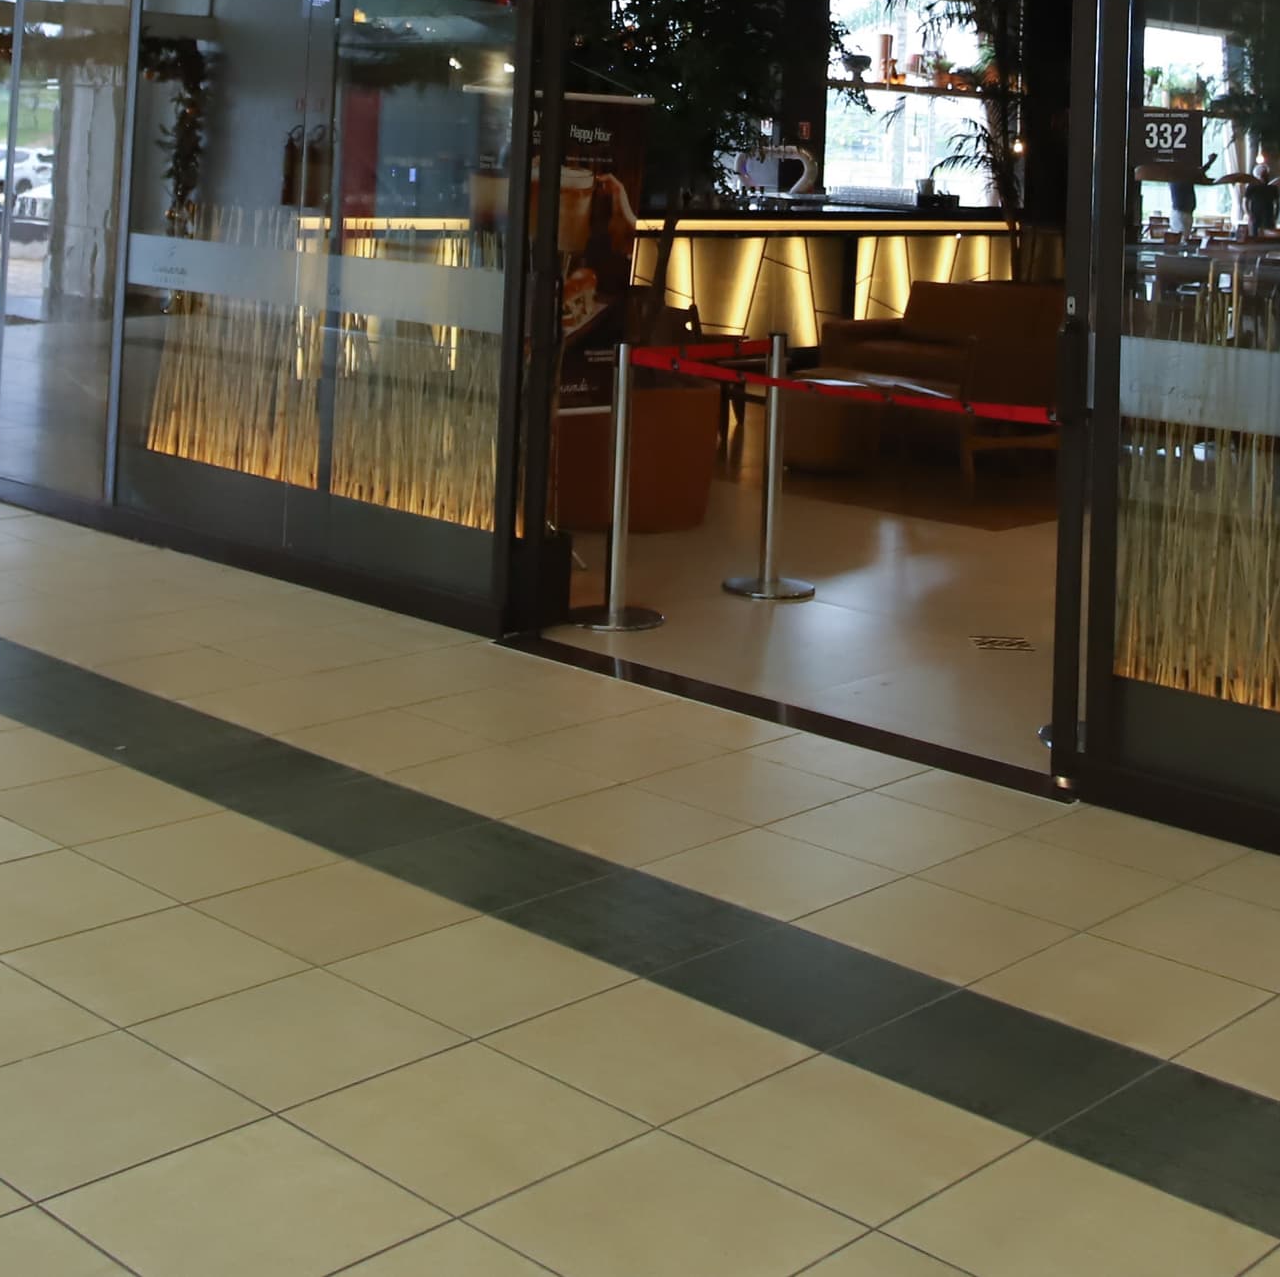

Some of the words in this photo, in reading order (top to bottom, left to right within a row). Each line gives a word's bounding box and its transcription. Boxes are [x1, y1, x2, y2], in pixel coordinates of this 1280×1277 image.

[569, 123, 593, 144] Happy
[593, 127, 613, 143] Hour
[1144, 122, 1188, 149] 332
